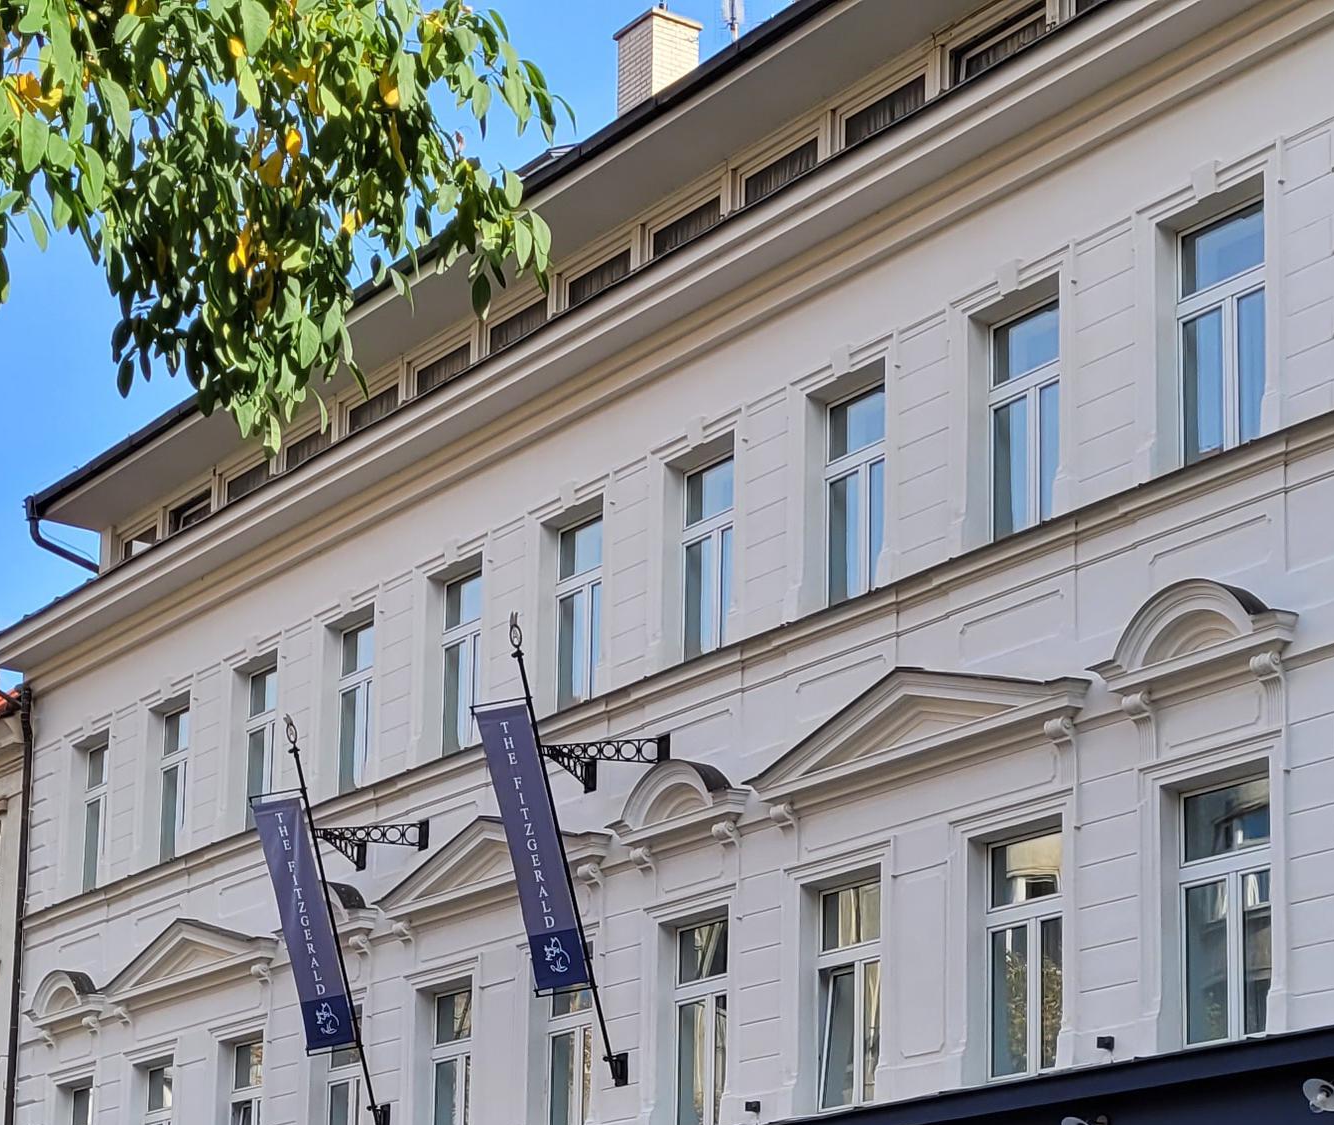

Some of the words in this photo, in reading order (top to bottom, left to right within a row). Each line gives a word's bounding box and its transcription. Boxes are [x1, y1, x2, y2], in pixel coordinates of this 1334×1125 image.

[275, 812, 291, 850] THE
[287, 861, 325, 995] FITZGERALD
[500, 721, 518, 765] THE
[513, 776, 555, 929] FITZGERALD
